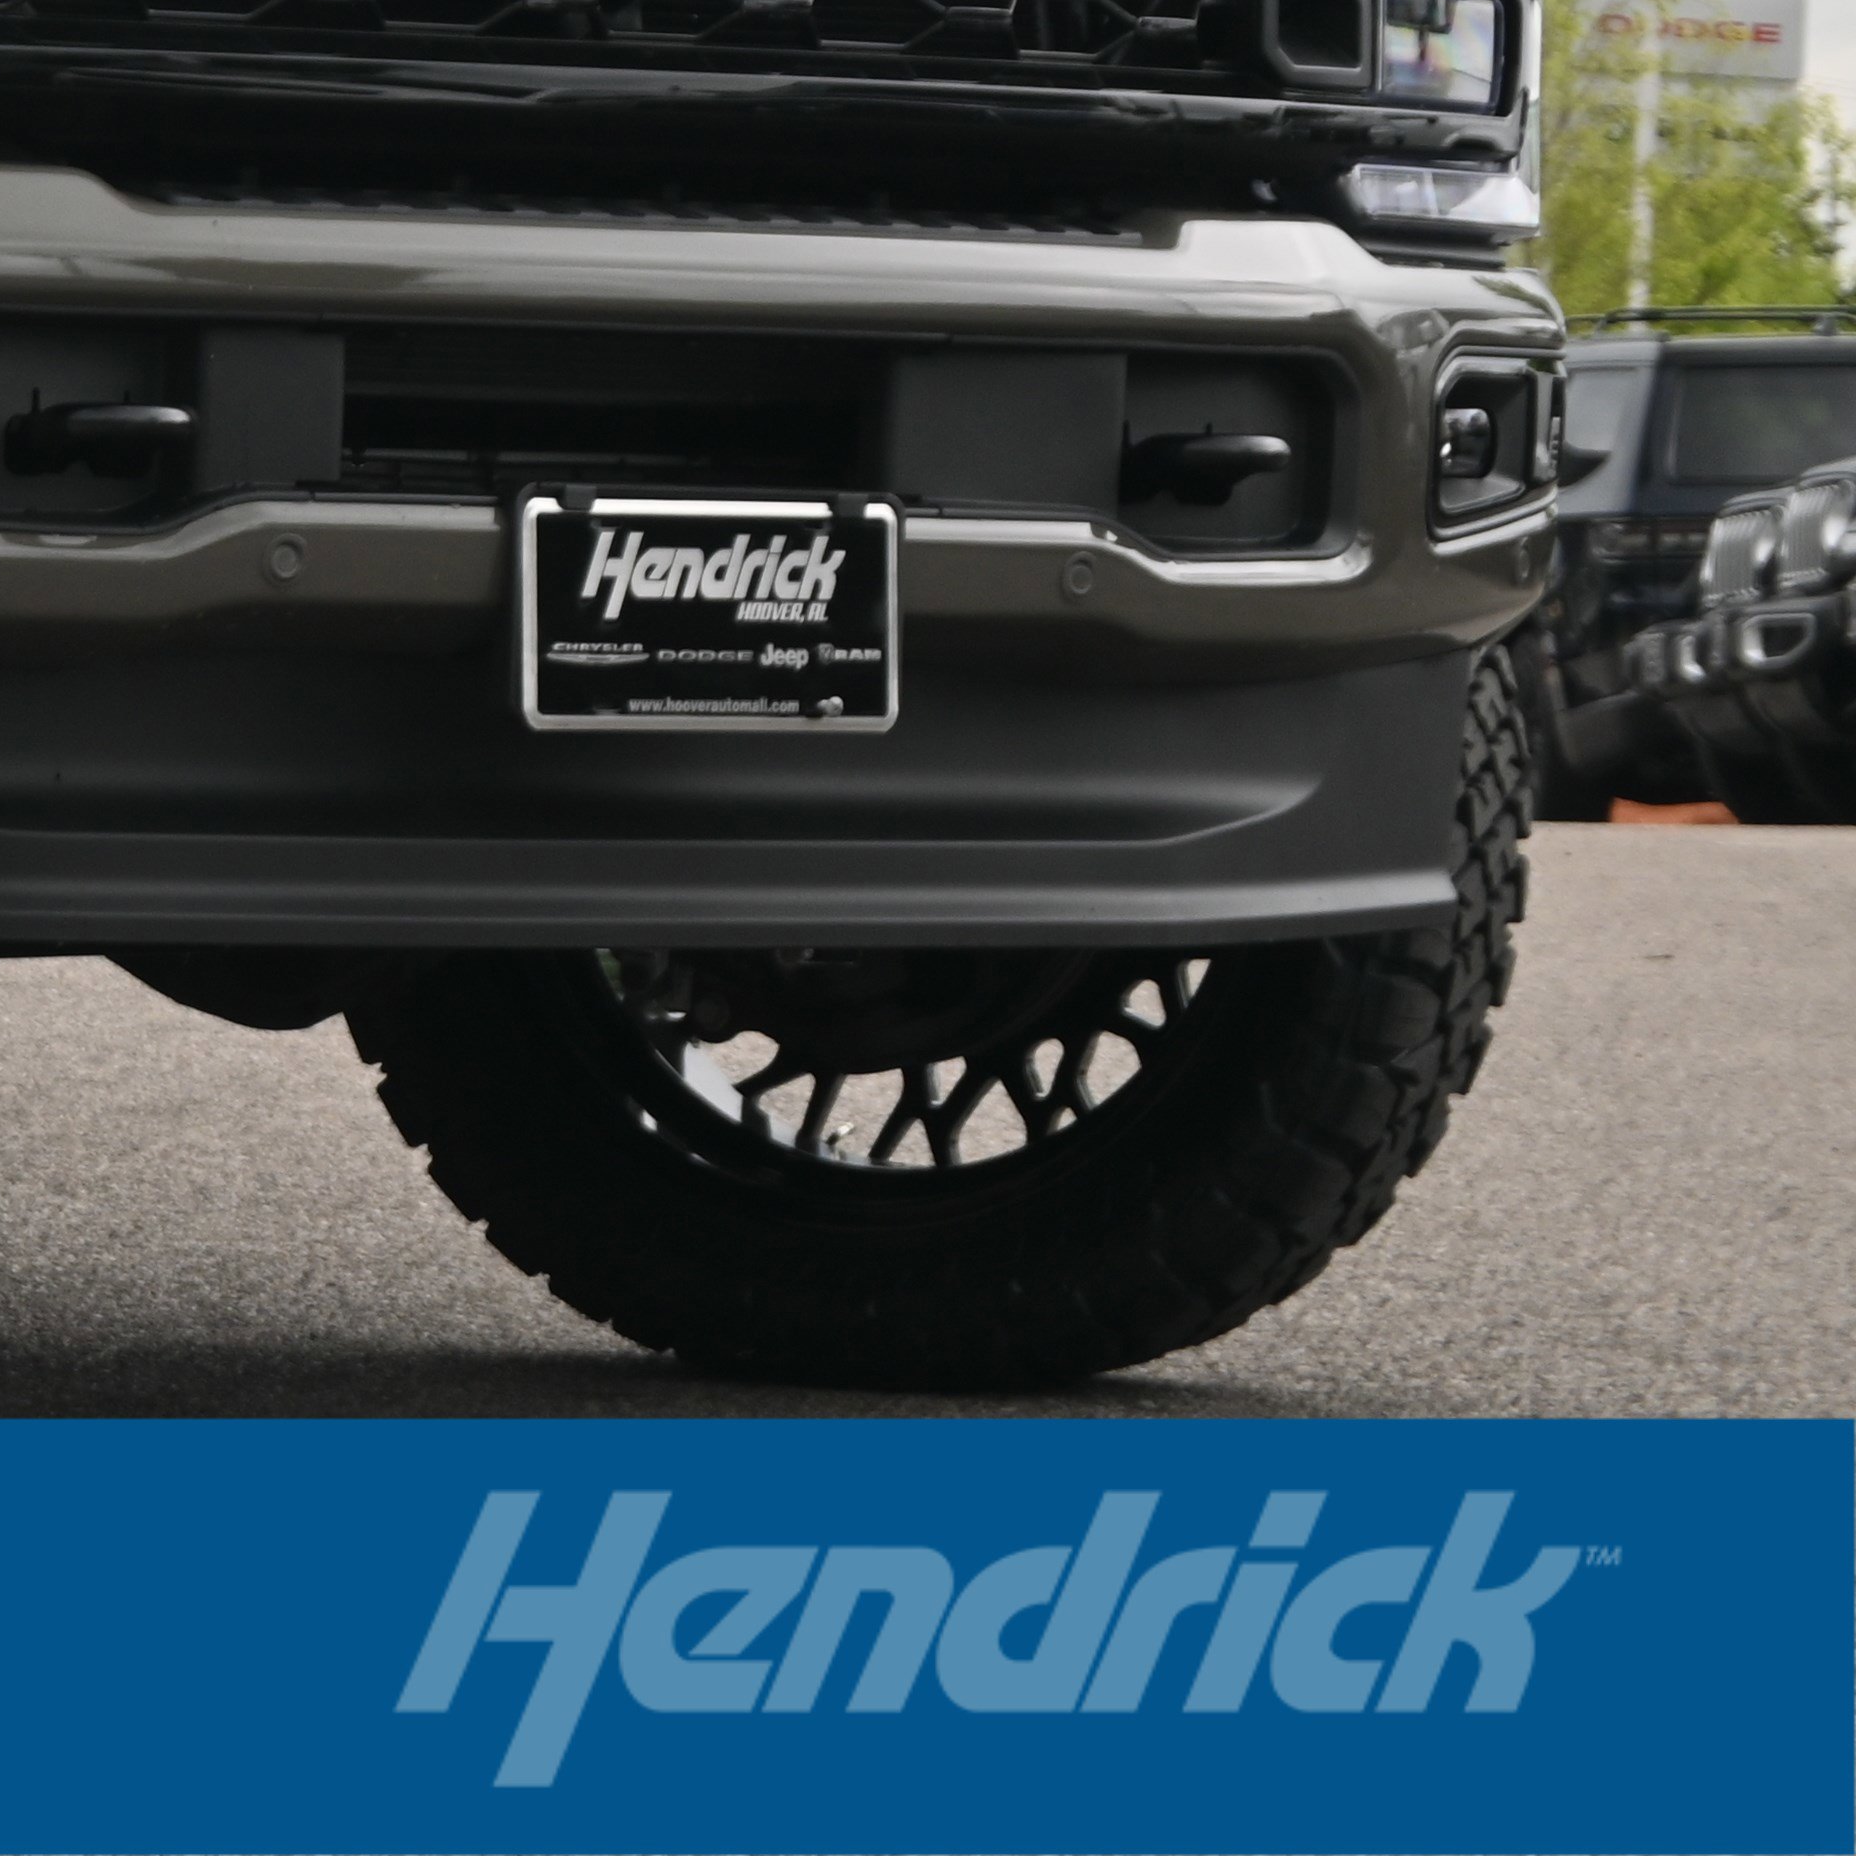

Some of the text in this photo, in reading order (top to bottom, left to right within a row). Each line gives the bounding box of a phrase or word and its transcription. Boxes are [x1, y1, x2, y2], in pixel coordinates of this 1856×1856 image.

[581, 531, 847, 621] Hendrick
[735, 602, 830, 623] HOOVER, AL
[657, 649, 755, 663] DODGE
[760, 643, 809, 670] Jeep
[834, 648, 883, 662] RAM
[628, 699, 800, 715] www.hooverautomall.com
